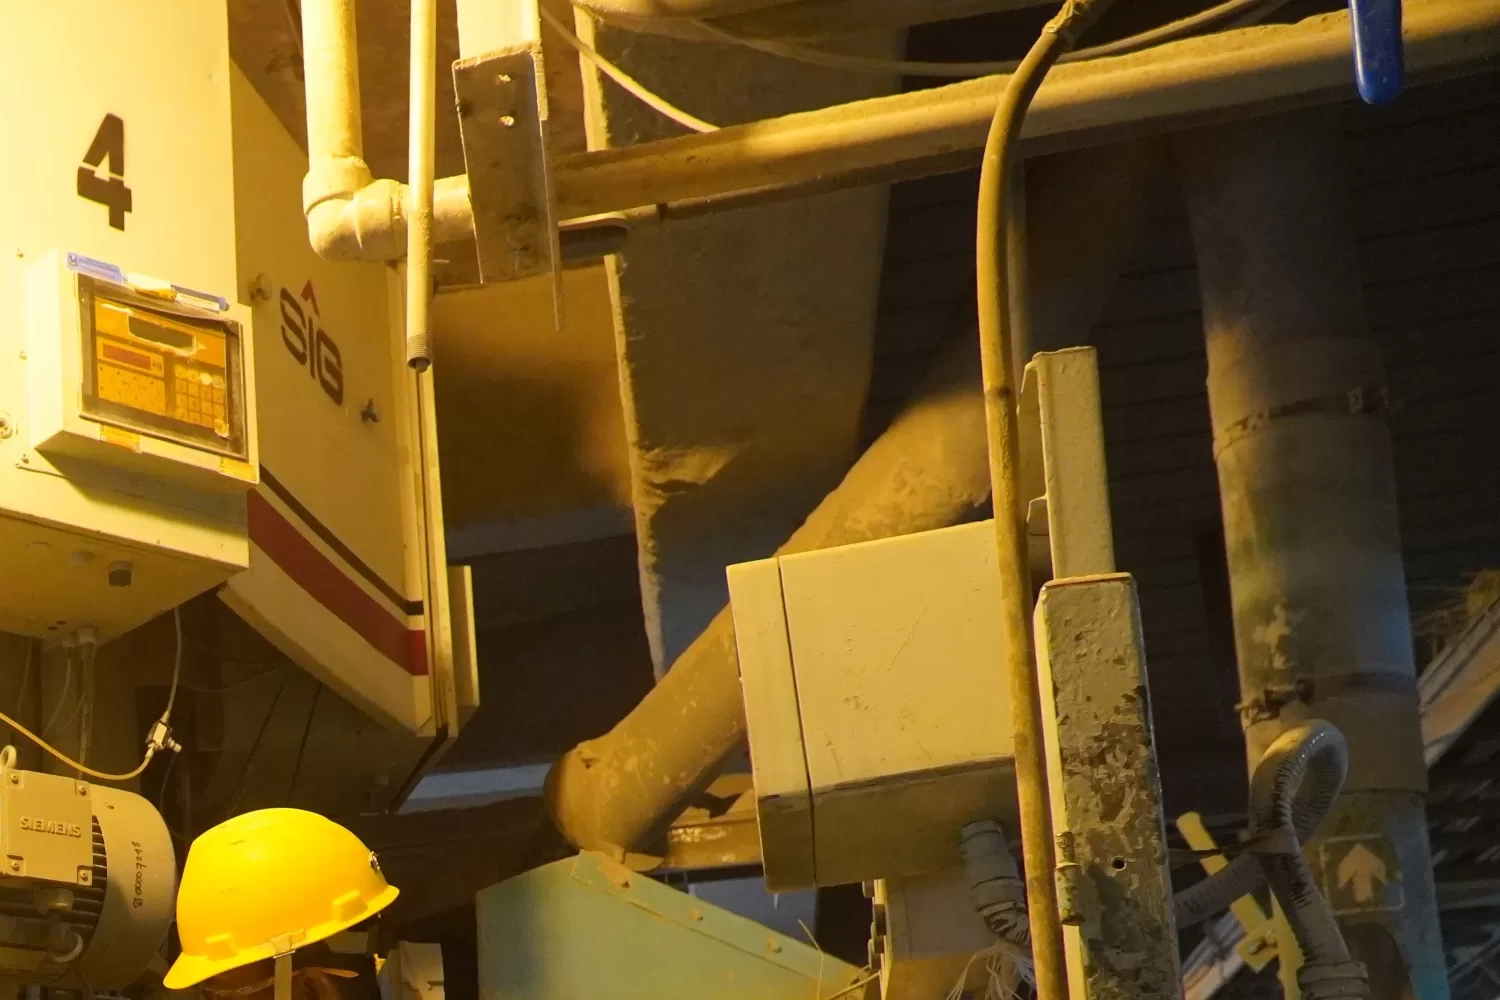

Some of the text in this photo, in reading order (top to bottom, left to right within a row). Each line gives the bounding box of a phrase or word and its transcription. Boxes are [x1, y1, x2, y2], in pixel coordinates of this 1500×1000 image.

[77, 112, 132, 231] 4
[280, 286, 344, 406] SIG
[20, 816, 81, 838] SIEMENS
